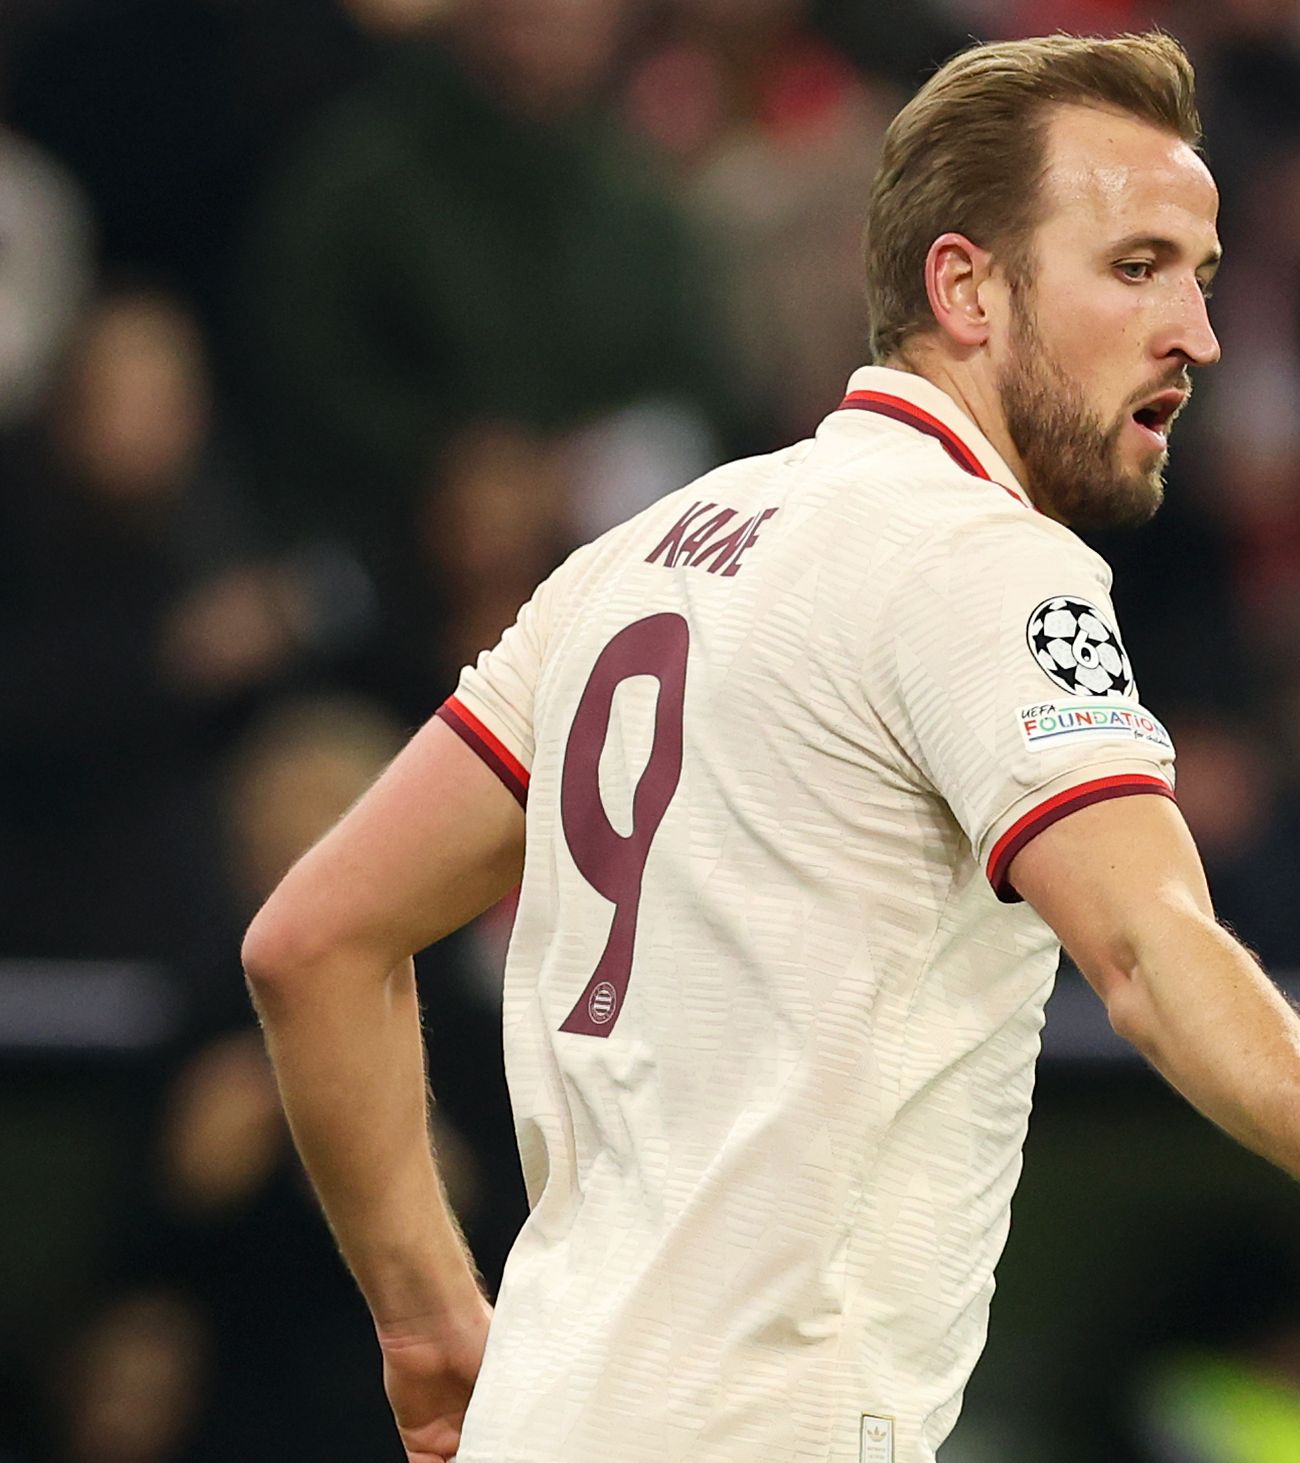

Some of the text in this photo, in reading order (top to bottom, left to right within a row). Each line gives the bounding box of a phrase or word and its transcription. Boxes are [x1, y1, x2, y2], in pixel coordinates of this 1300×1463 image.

[644, 501, 779, 577] KANE
[1071, 630, 1101, 670] 6
[1021, 704, 1057, 719] UEFA
[557, 612, 690, 1039] 9
